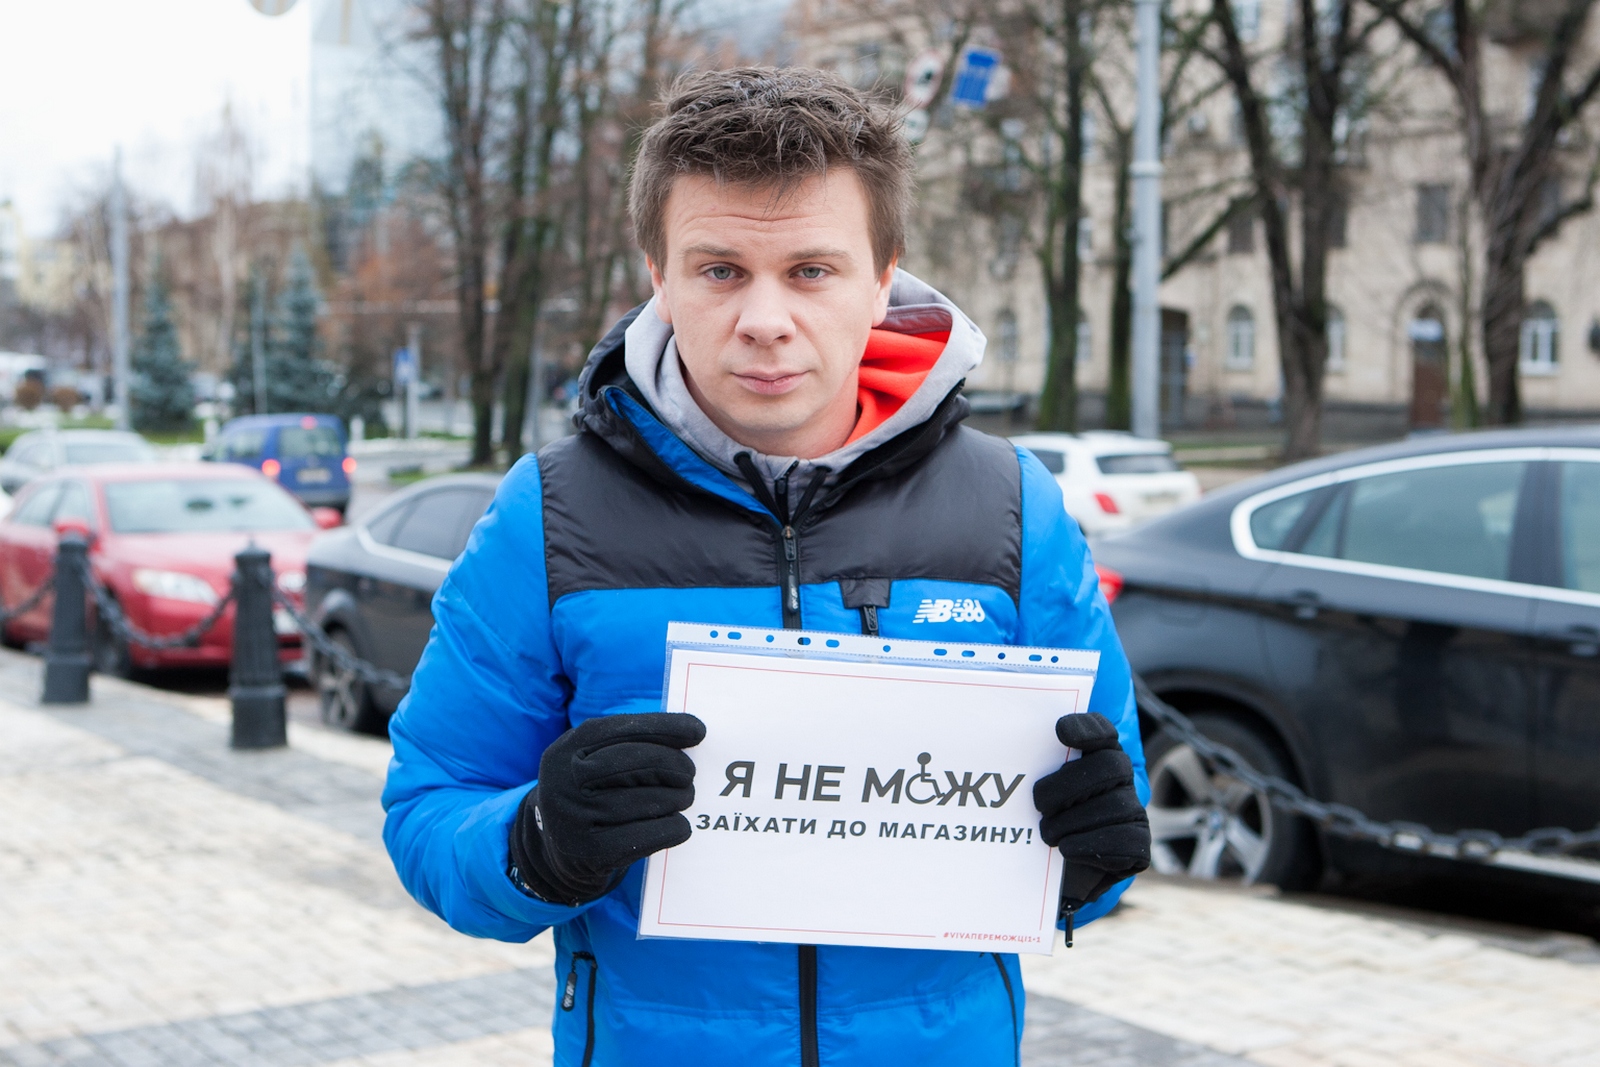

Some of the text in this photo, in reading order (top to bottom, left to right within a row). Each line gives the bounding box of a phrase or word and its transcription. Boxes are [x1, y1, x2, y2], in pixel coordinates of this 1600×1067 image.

[719, 760, 756, 798] Я
[774, 763, 846, 802] НЕ
[695, 812, 1033, 845] ЗАЇХАТИ ДО МАГАЗИНУ!
